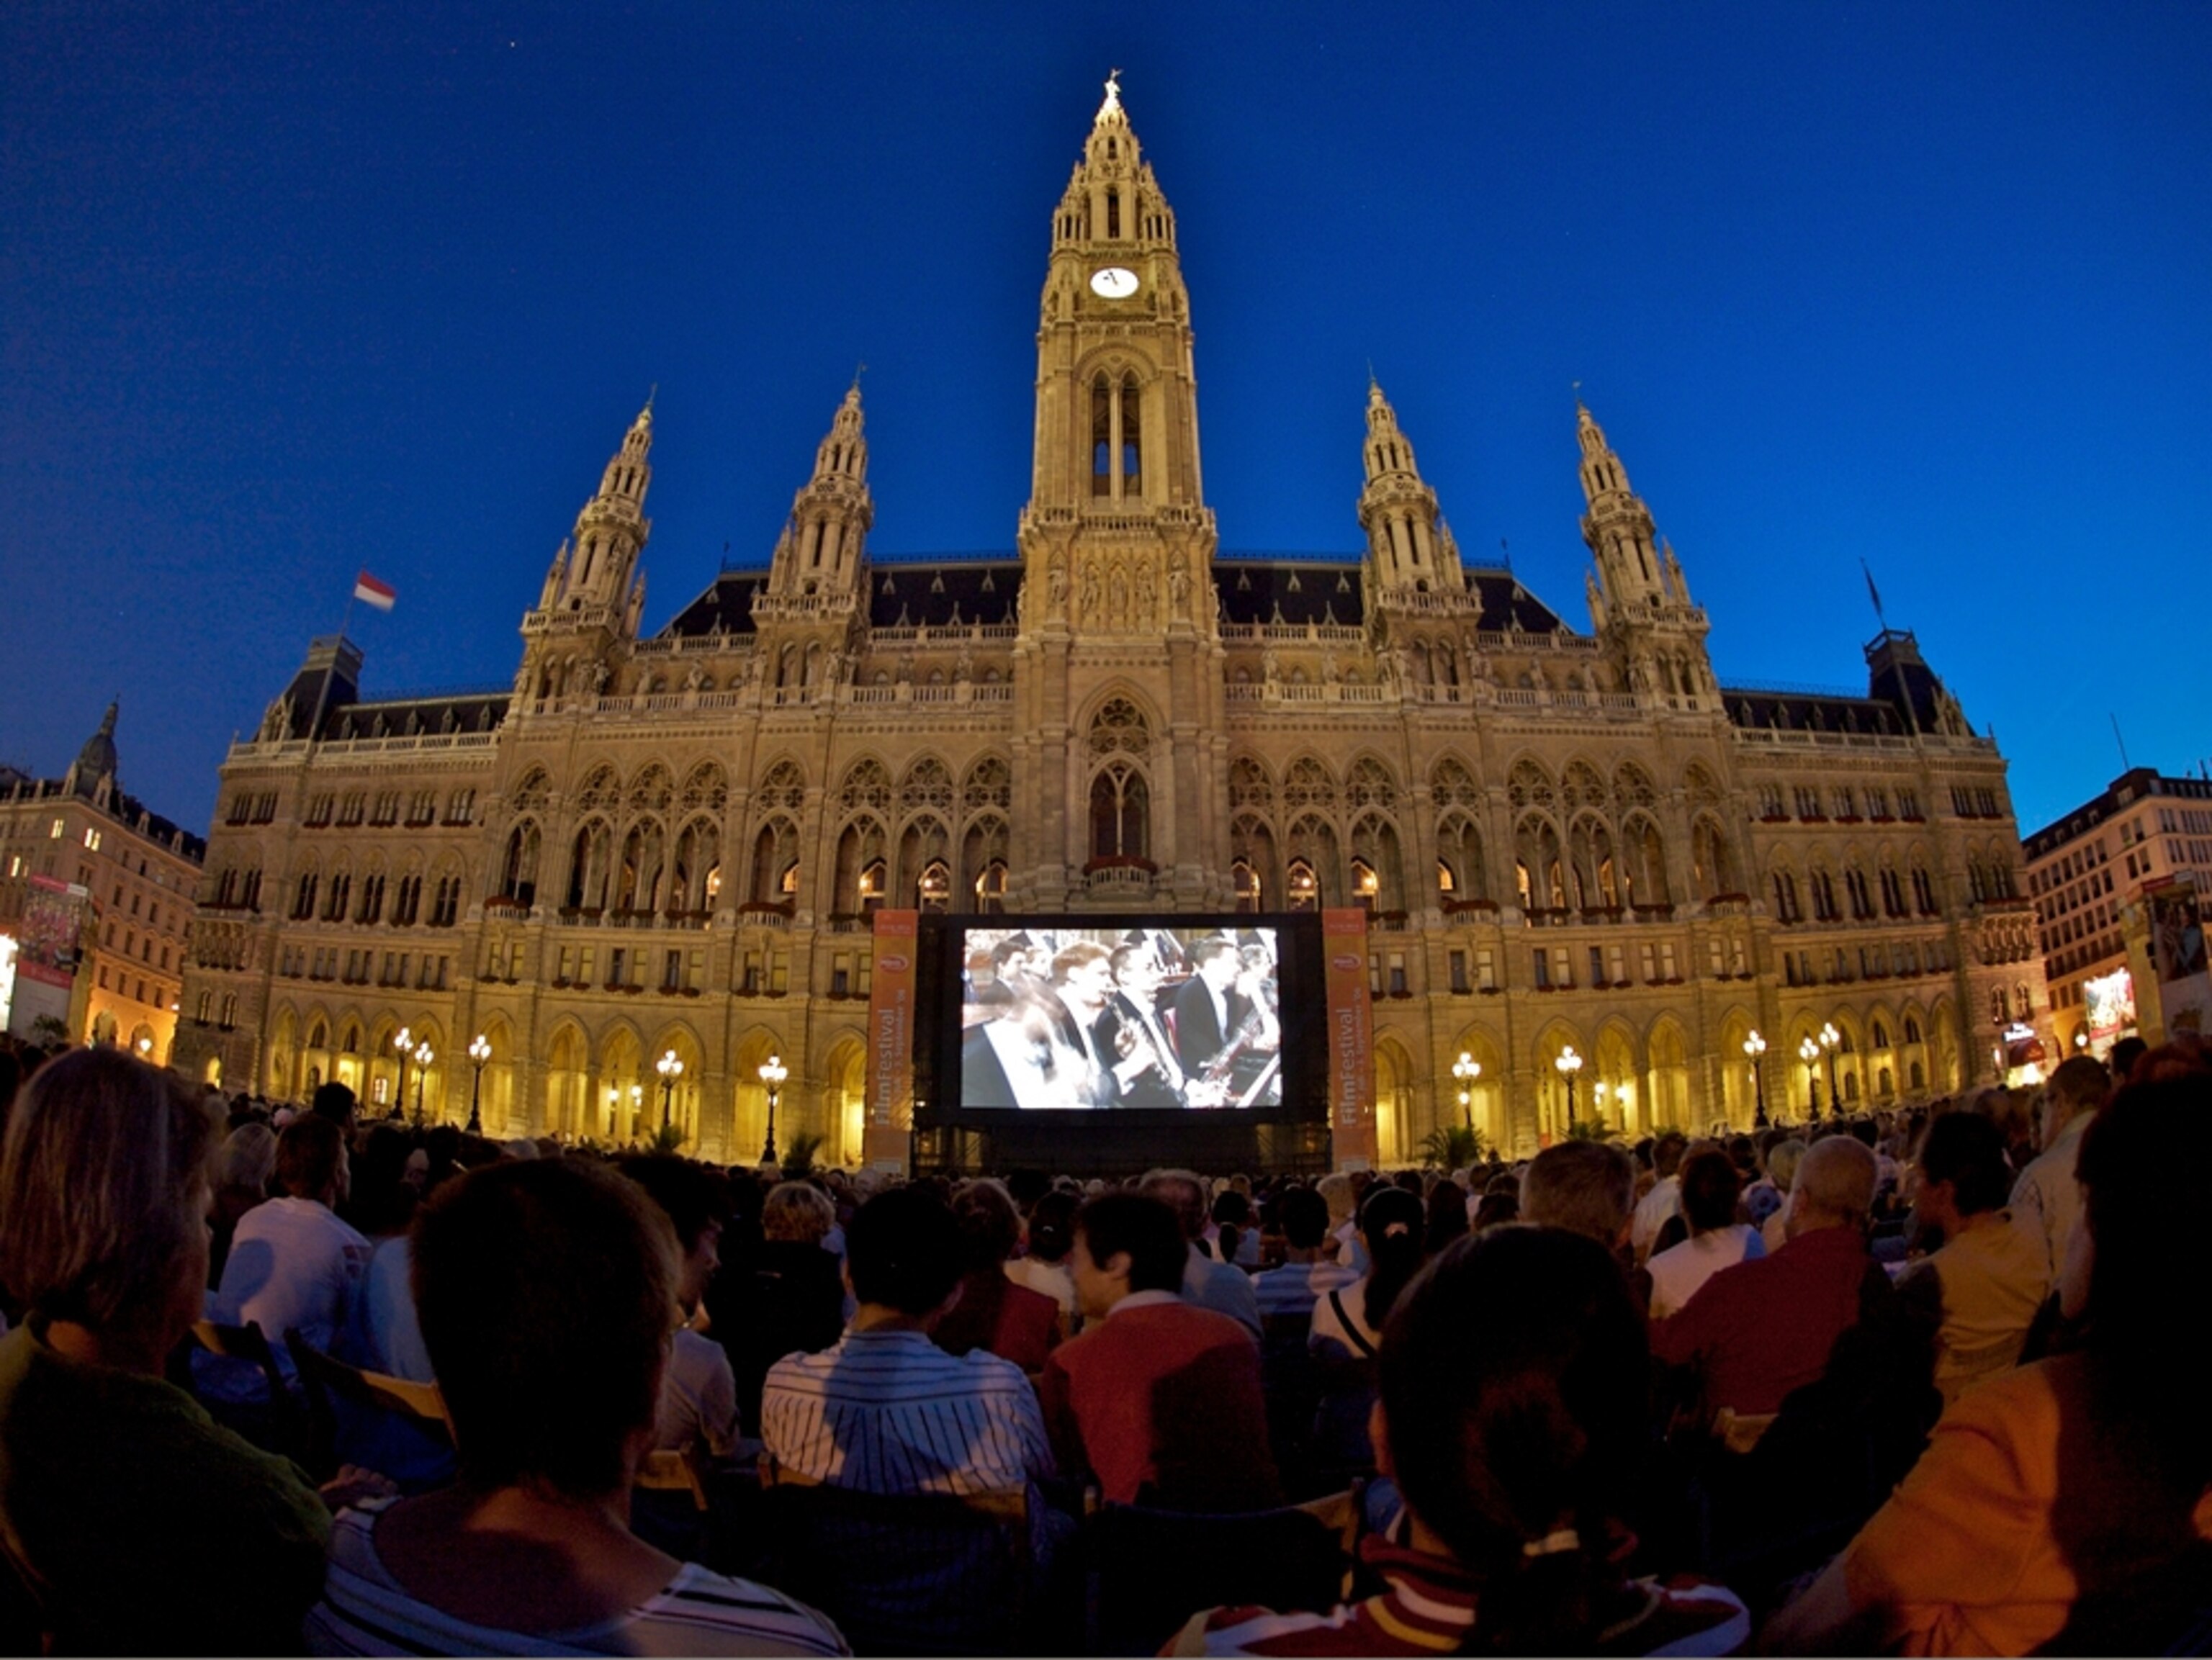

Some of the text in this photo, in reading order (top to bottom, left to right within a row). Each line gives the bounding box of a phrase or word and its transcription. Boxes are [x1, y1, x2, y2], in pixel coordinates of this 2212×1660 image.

[873, 1009, 894, 1125] FilmFestival
[894, 1006, 905, 1057] September
[1336, 1009, 1357, 1125] FilmFestival
[1354, 1004, 1365, 1055] September
